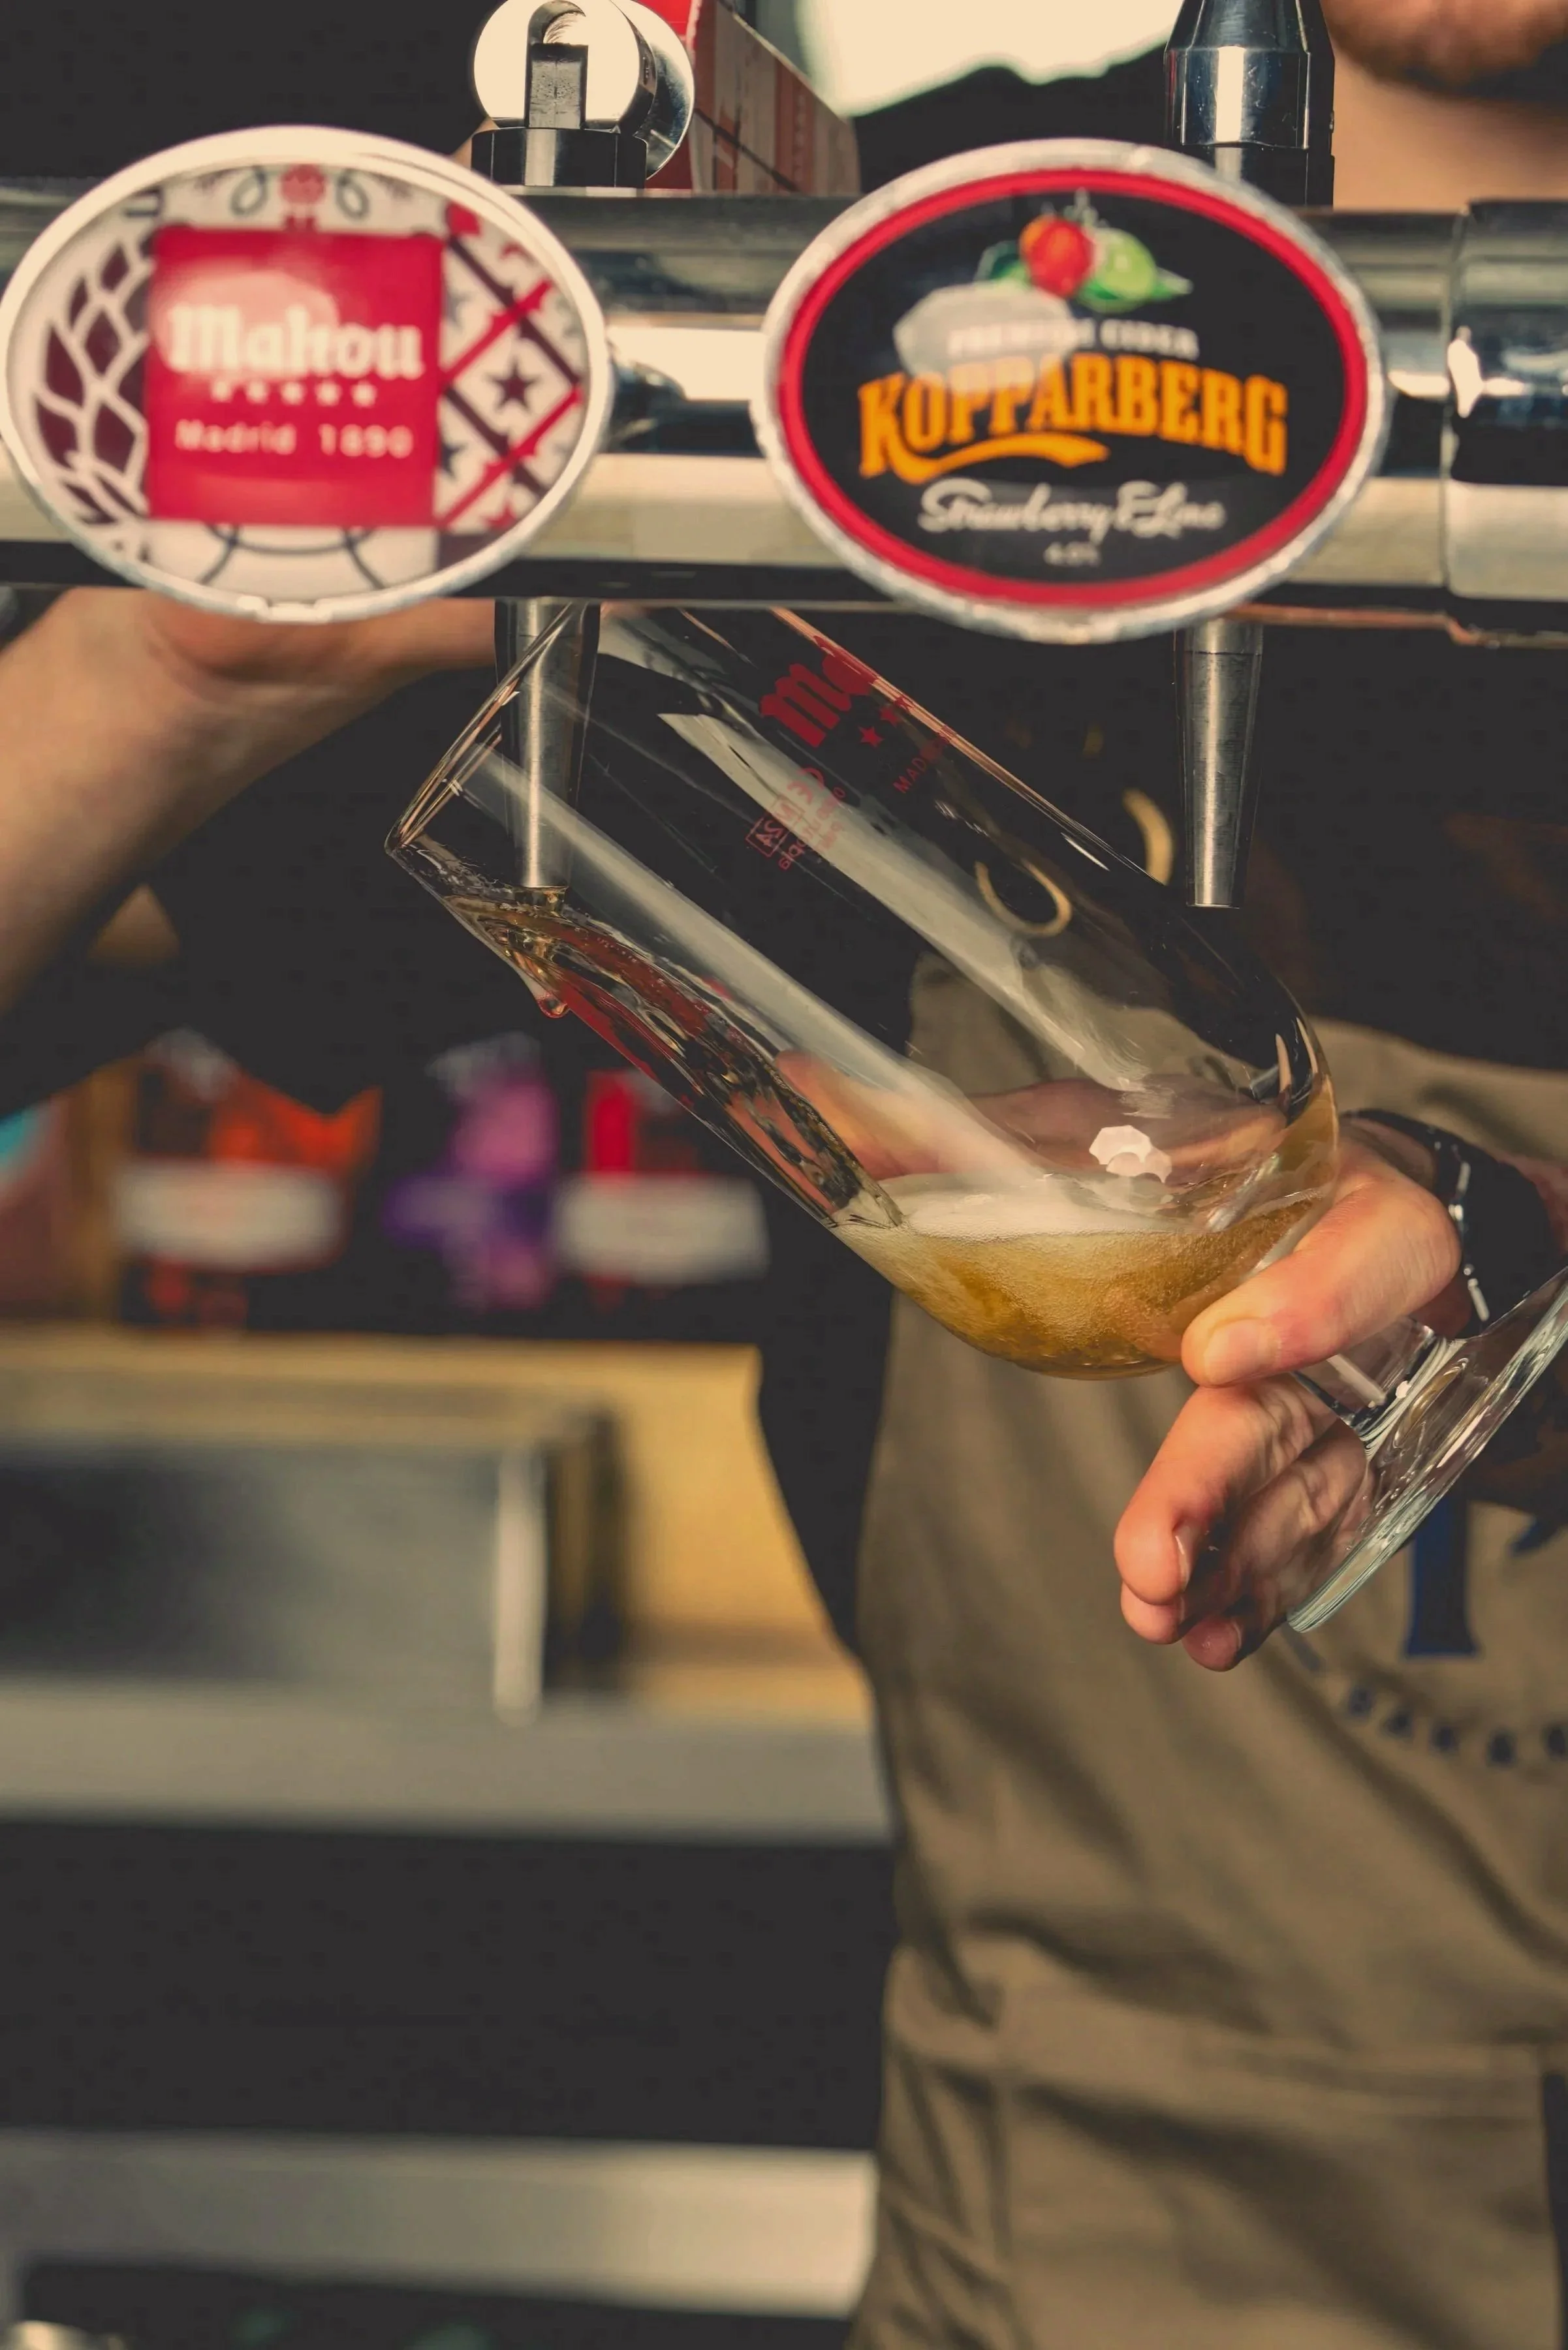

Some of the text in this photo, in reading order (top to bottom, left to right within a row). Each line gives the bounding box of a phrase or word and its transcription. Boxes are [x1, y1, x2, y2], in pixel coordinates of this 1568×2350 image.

[168, 304, 426, 381] Mahou
[1099, 318, 1199, 360] CIDER
[174, 418, 415, 459] Madrid 1890
[858, 352, 1288, 484] KOPPARBERG
[917, 477, 1109, 545] Strawberry
